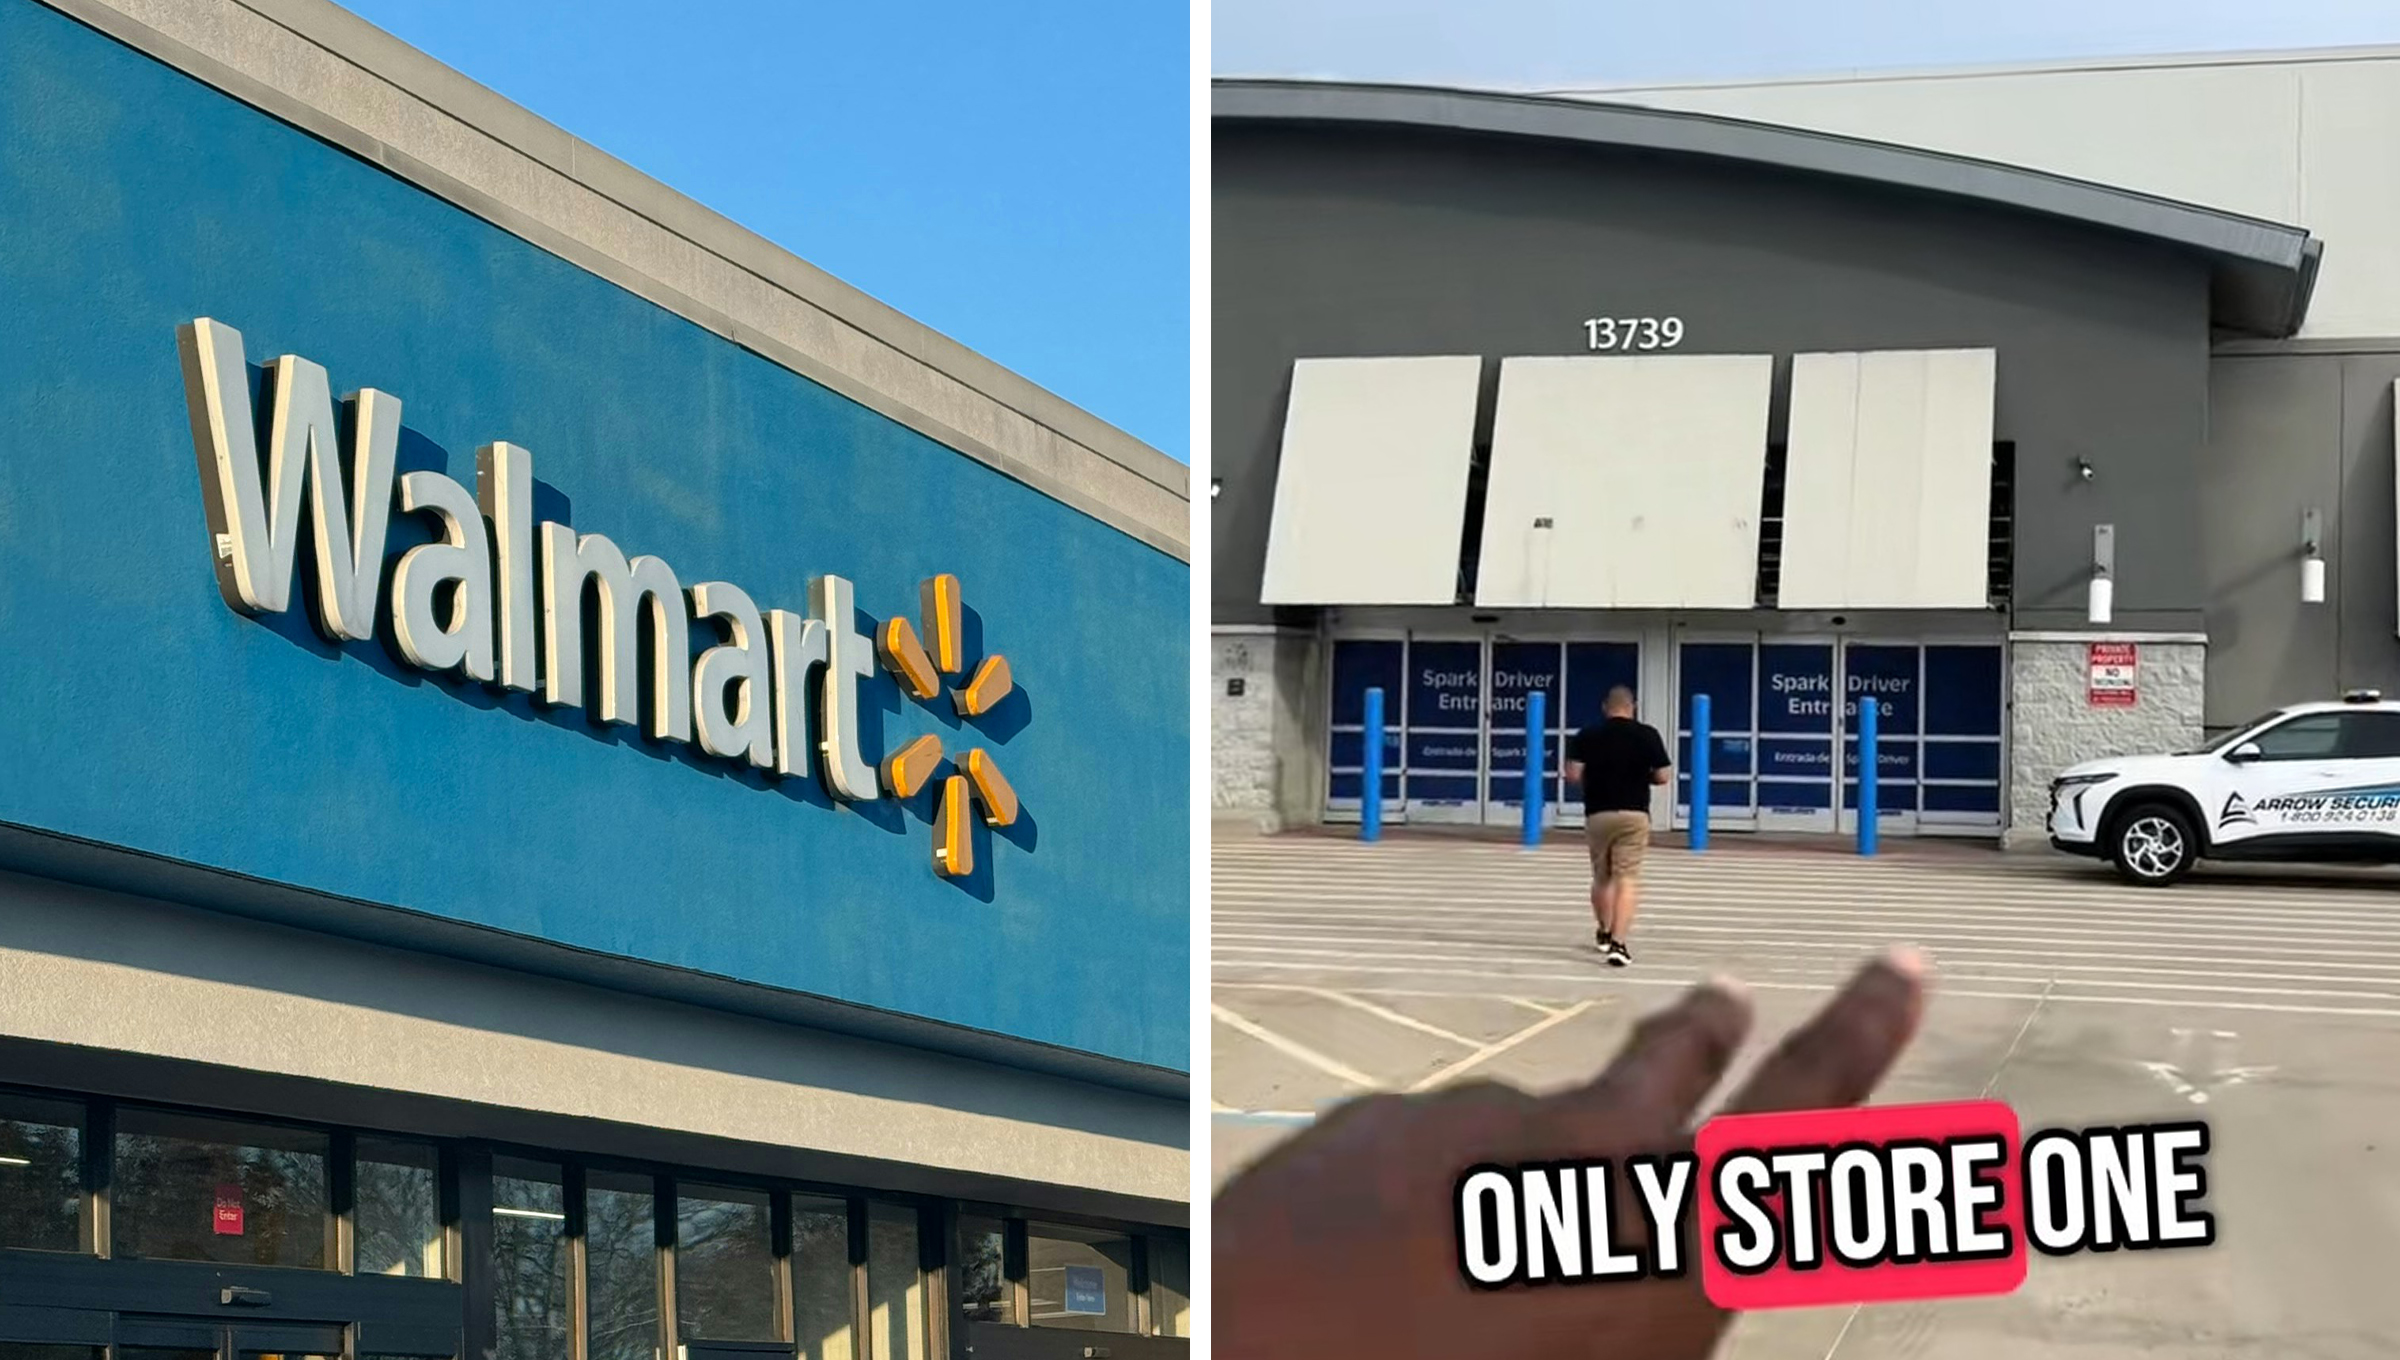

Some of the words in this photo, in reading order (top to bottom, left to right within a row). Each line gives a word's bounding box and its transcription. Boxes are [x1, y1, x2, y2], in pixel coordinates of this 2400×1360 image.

[1583, 316, 1685, 350] 13739
[176, 316, 880, 802] Walmart
[1422, 669, 1478, 689] Spark
[1494, 670, 1554, 688] Driver
[2105, 667, 2120, 678] NO
[1771, 673, 1830, 693] Spark
[1848, 675, 1910, 692] Driver
[2252, 797, 2328, 811] ARROW
